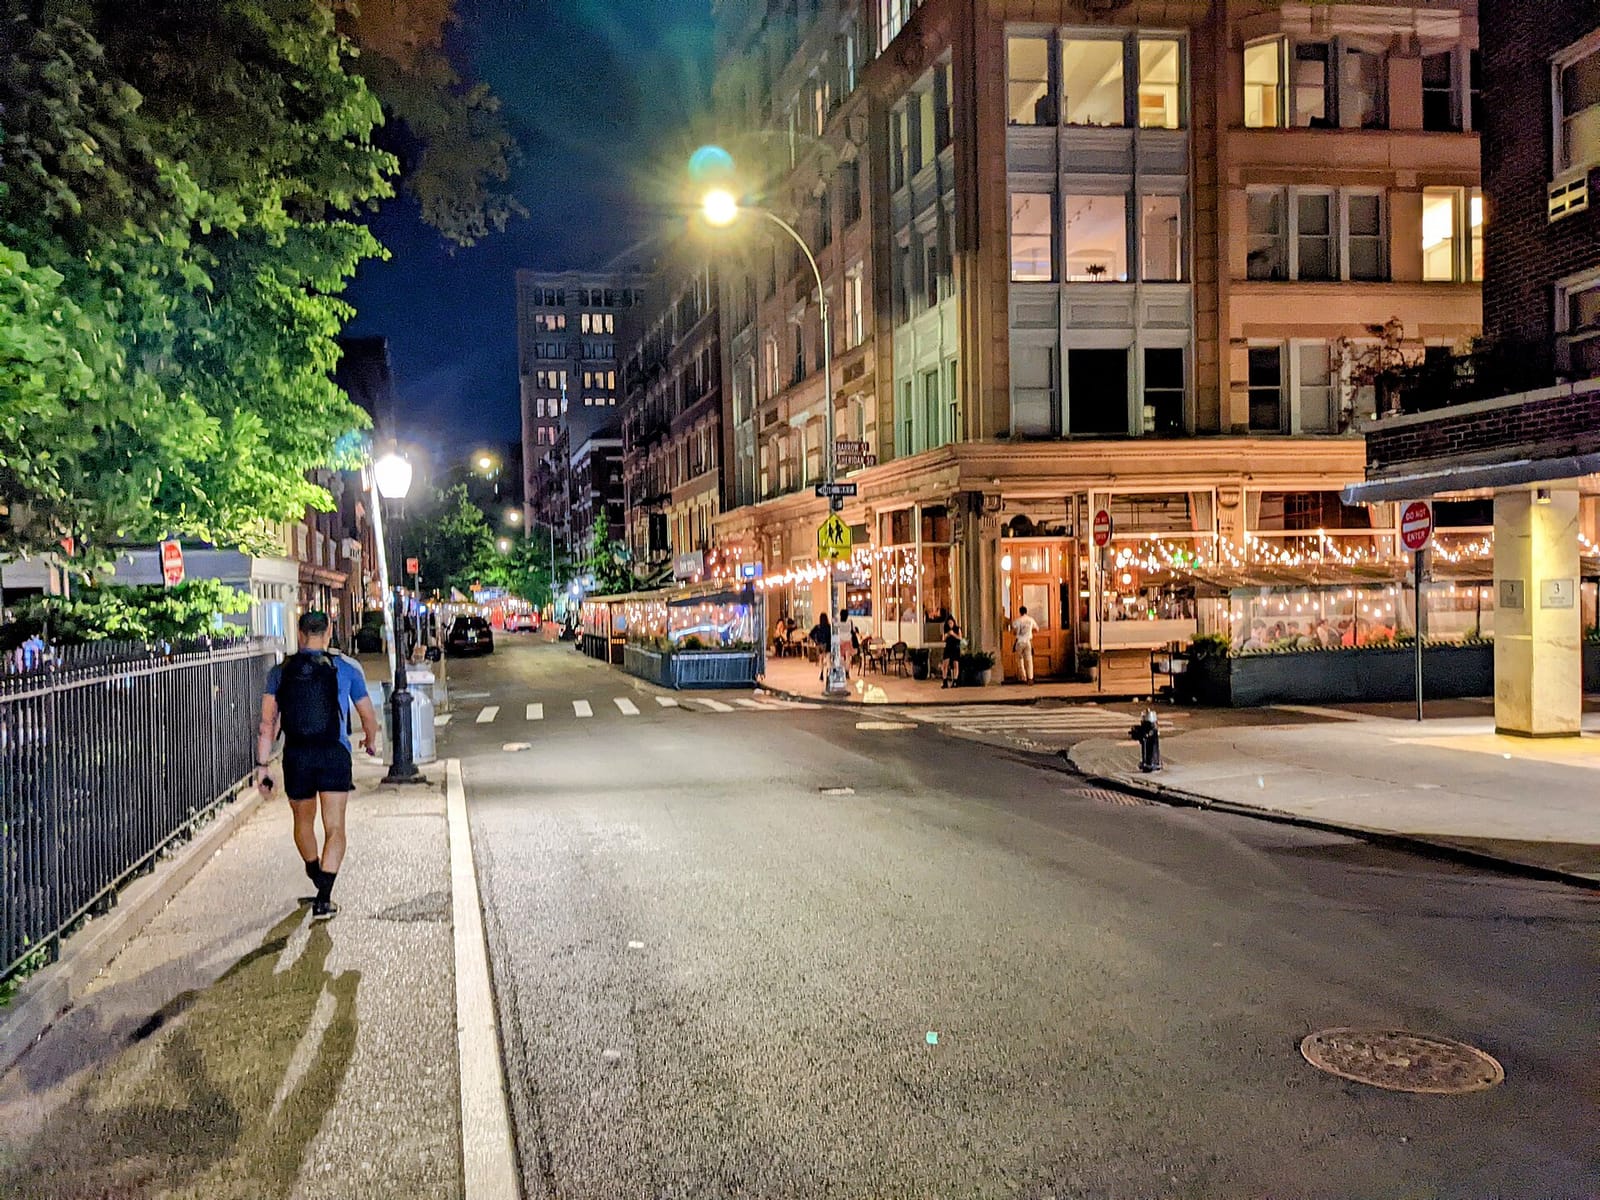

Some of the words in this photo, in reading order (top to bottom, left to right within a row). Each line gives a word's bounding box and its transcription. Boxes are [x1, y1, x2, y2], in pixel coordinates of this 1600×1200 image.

[1406, 512, 1414, 520] DO
[1415, 508, 1426, 518] NOT
[1407, 530, 1425, 542] ENTER
[1554, 582, 1560, 594] 3
